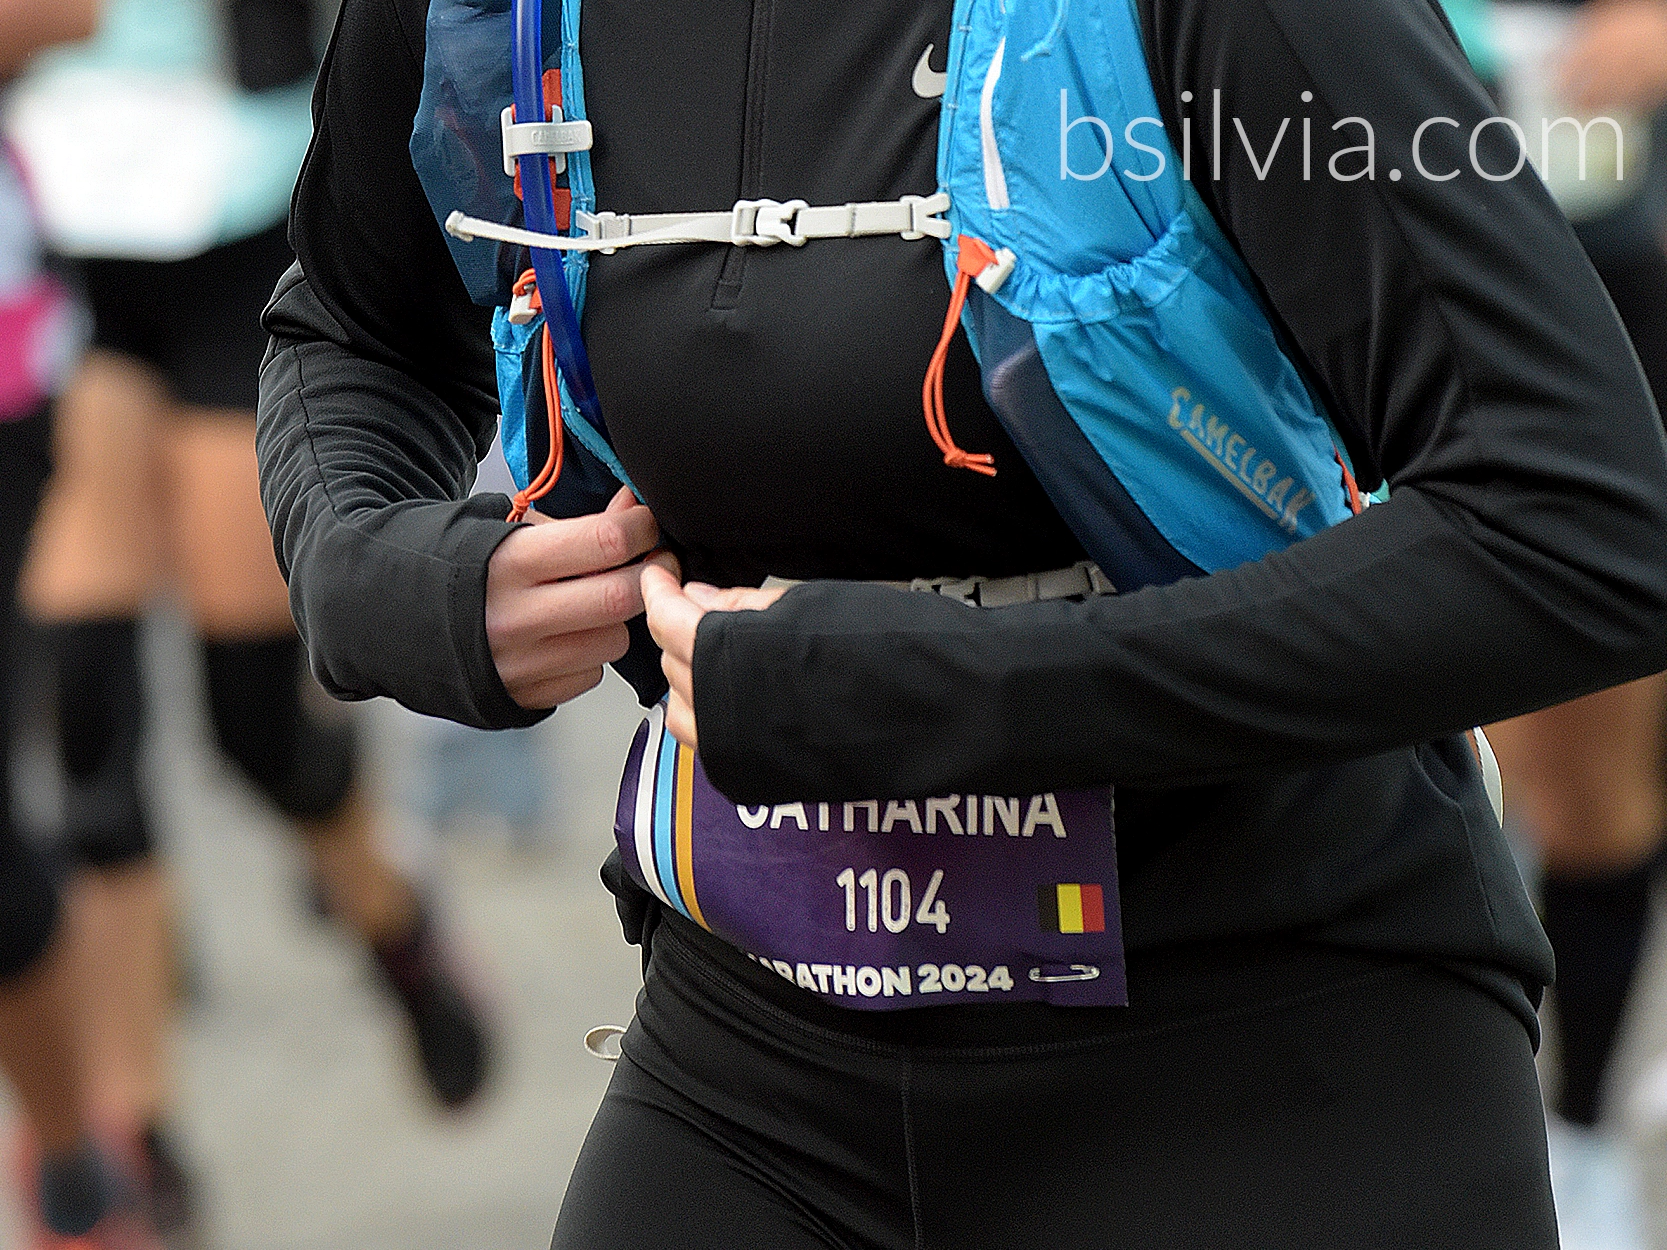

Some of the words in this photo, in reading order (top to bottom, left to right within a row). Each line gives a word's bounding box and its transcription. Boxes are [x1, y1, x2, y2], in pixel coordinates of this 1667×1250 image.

[1167, 386, 1314, 533] CAMELBAK
[836, 868, 950, 933] 1104
[747, 952, 912, 997] ATHON
[918, 963, 1014, 992] 2024
